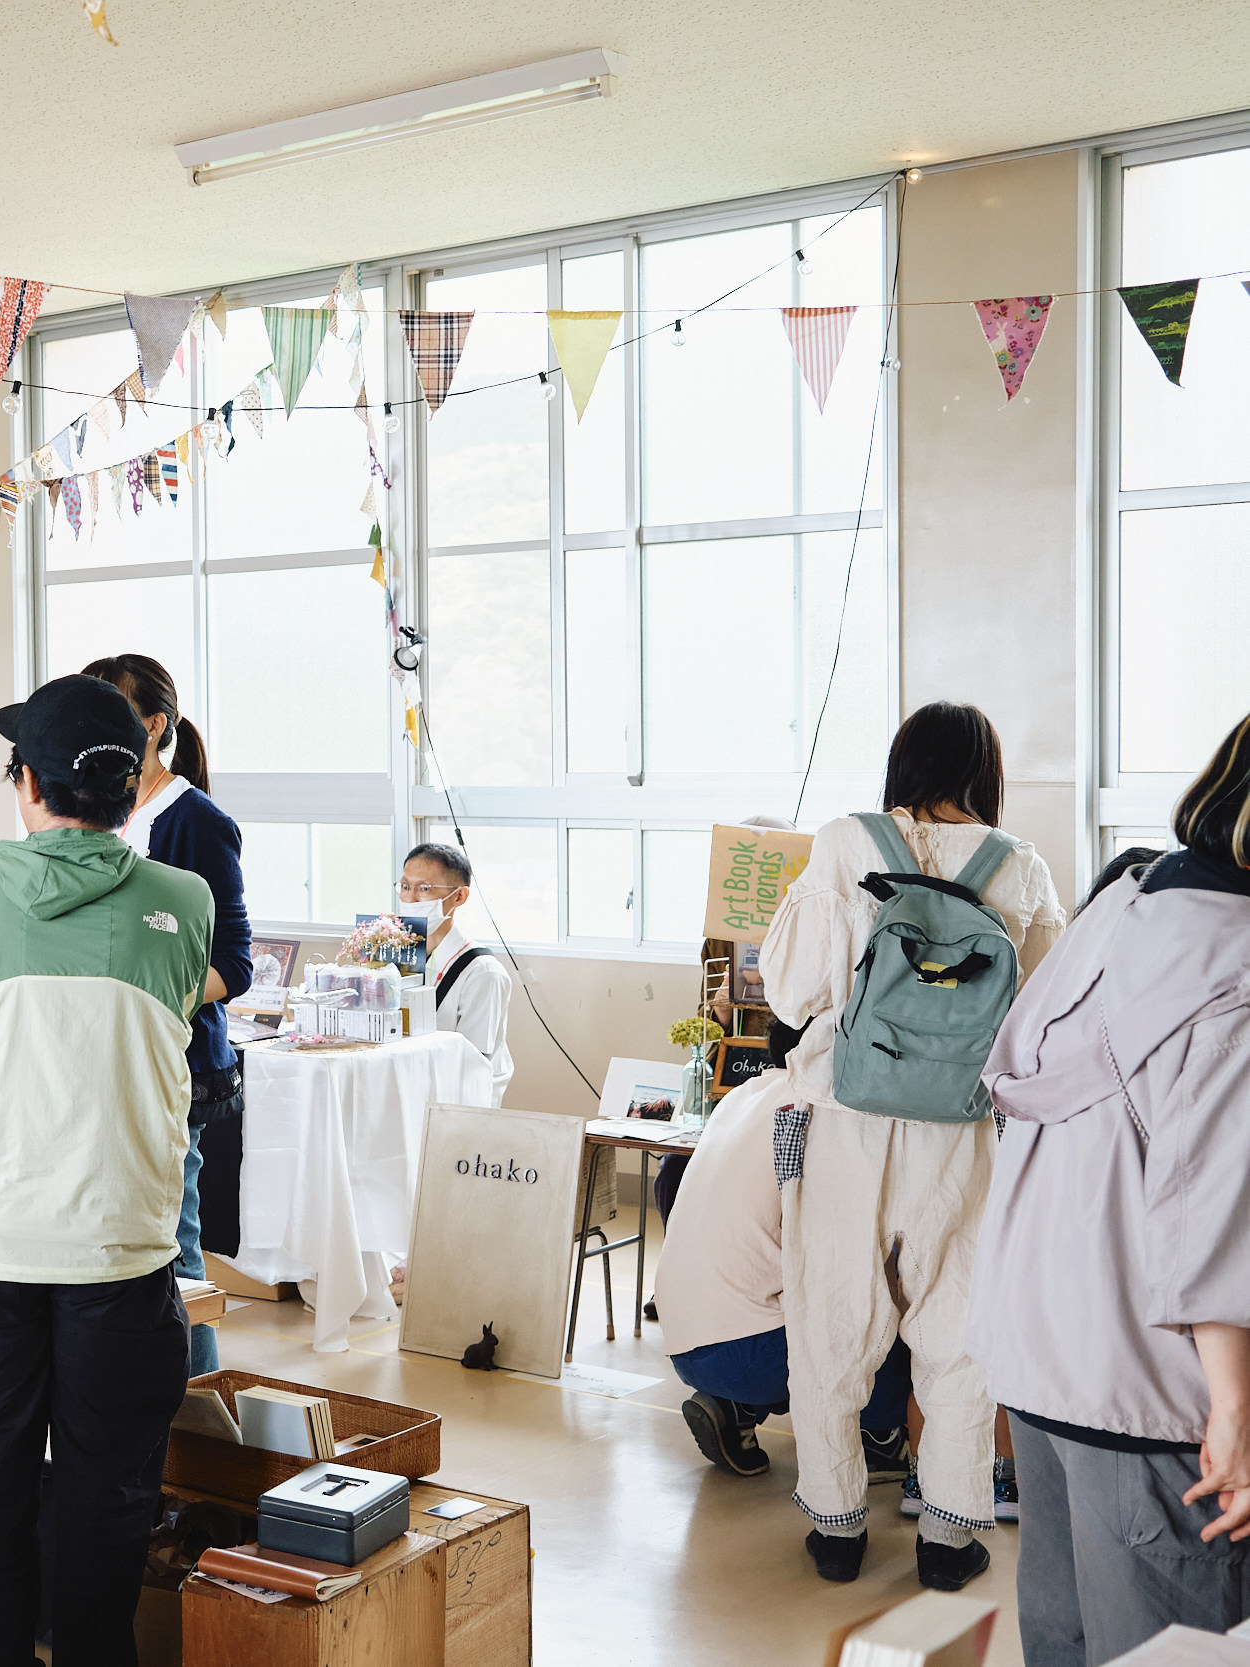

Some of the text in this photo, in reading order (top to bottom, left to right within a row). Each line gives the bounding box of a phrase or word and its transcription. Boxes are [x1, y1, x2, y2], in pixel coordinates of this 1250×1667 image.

[722, 840, 758, 931] Art Book
[750, 851, 784, 927] Friends
[143, 914, 167, 925] NORTH
[154, 910, 168, 919] THE
[149, 922, 167, 931] FACE
[455, 1153, 538, 1184] ohako
